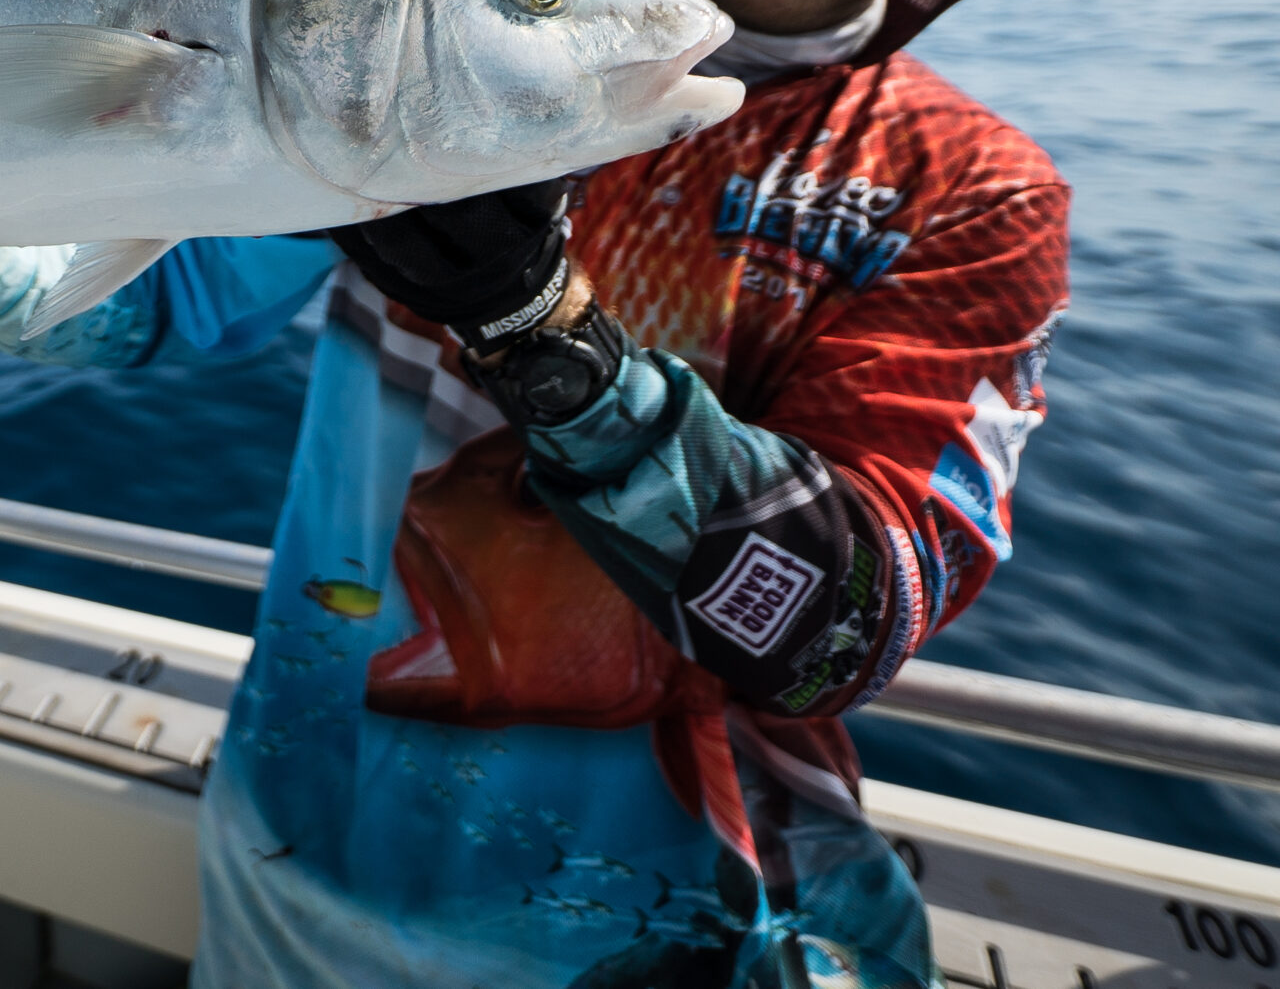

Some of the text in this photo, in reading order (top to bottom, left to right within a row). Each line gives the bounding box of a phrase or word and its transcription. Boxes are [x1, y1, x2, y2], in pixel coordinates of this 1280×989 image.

[716, 562, 773, 621] BANK
[740, 573, 796, 633] FOOD
[1165, 899, 1276, 968] 100
